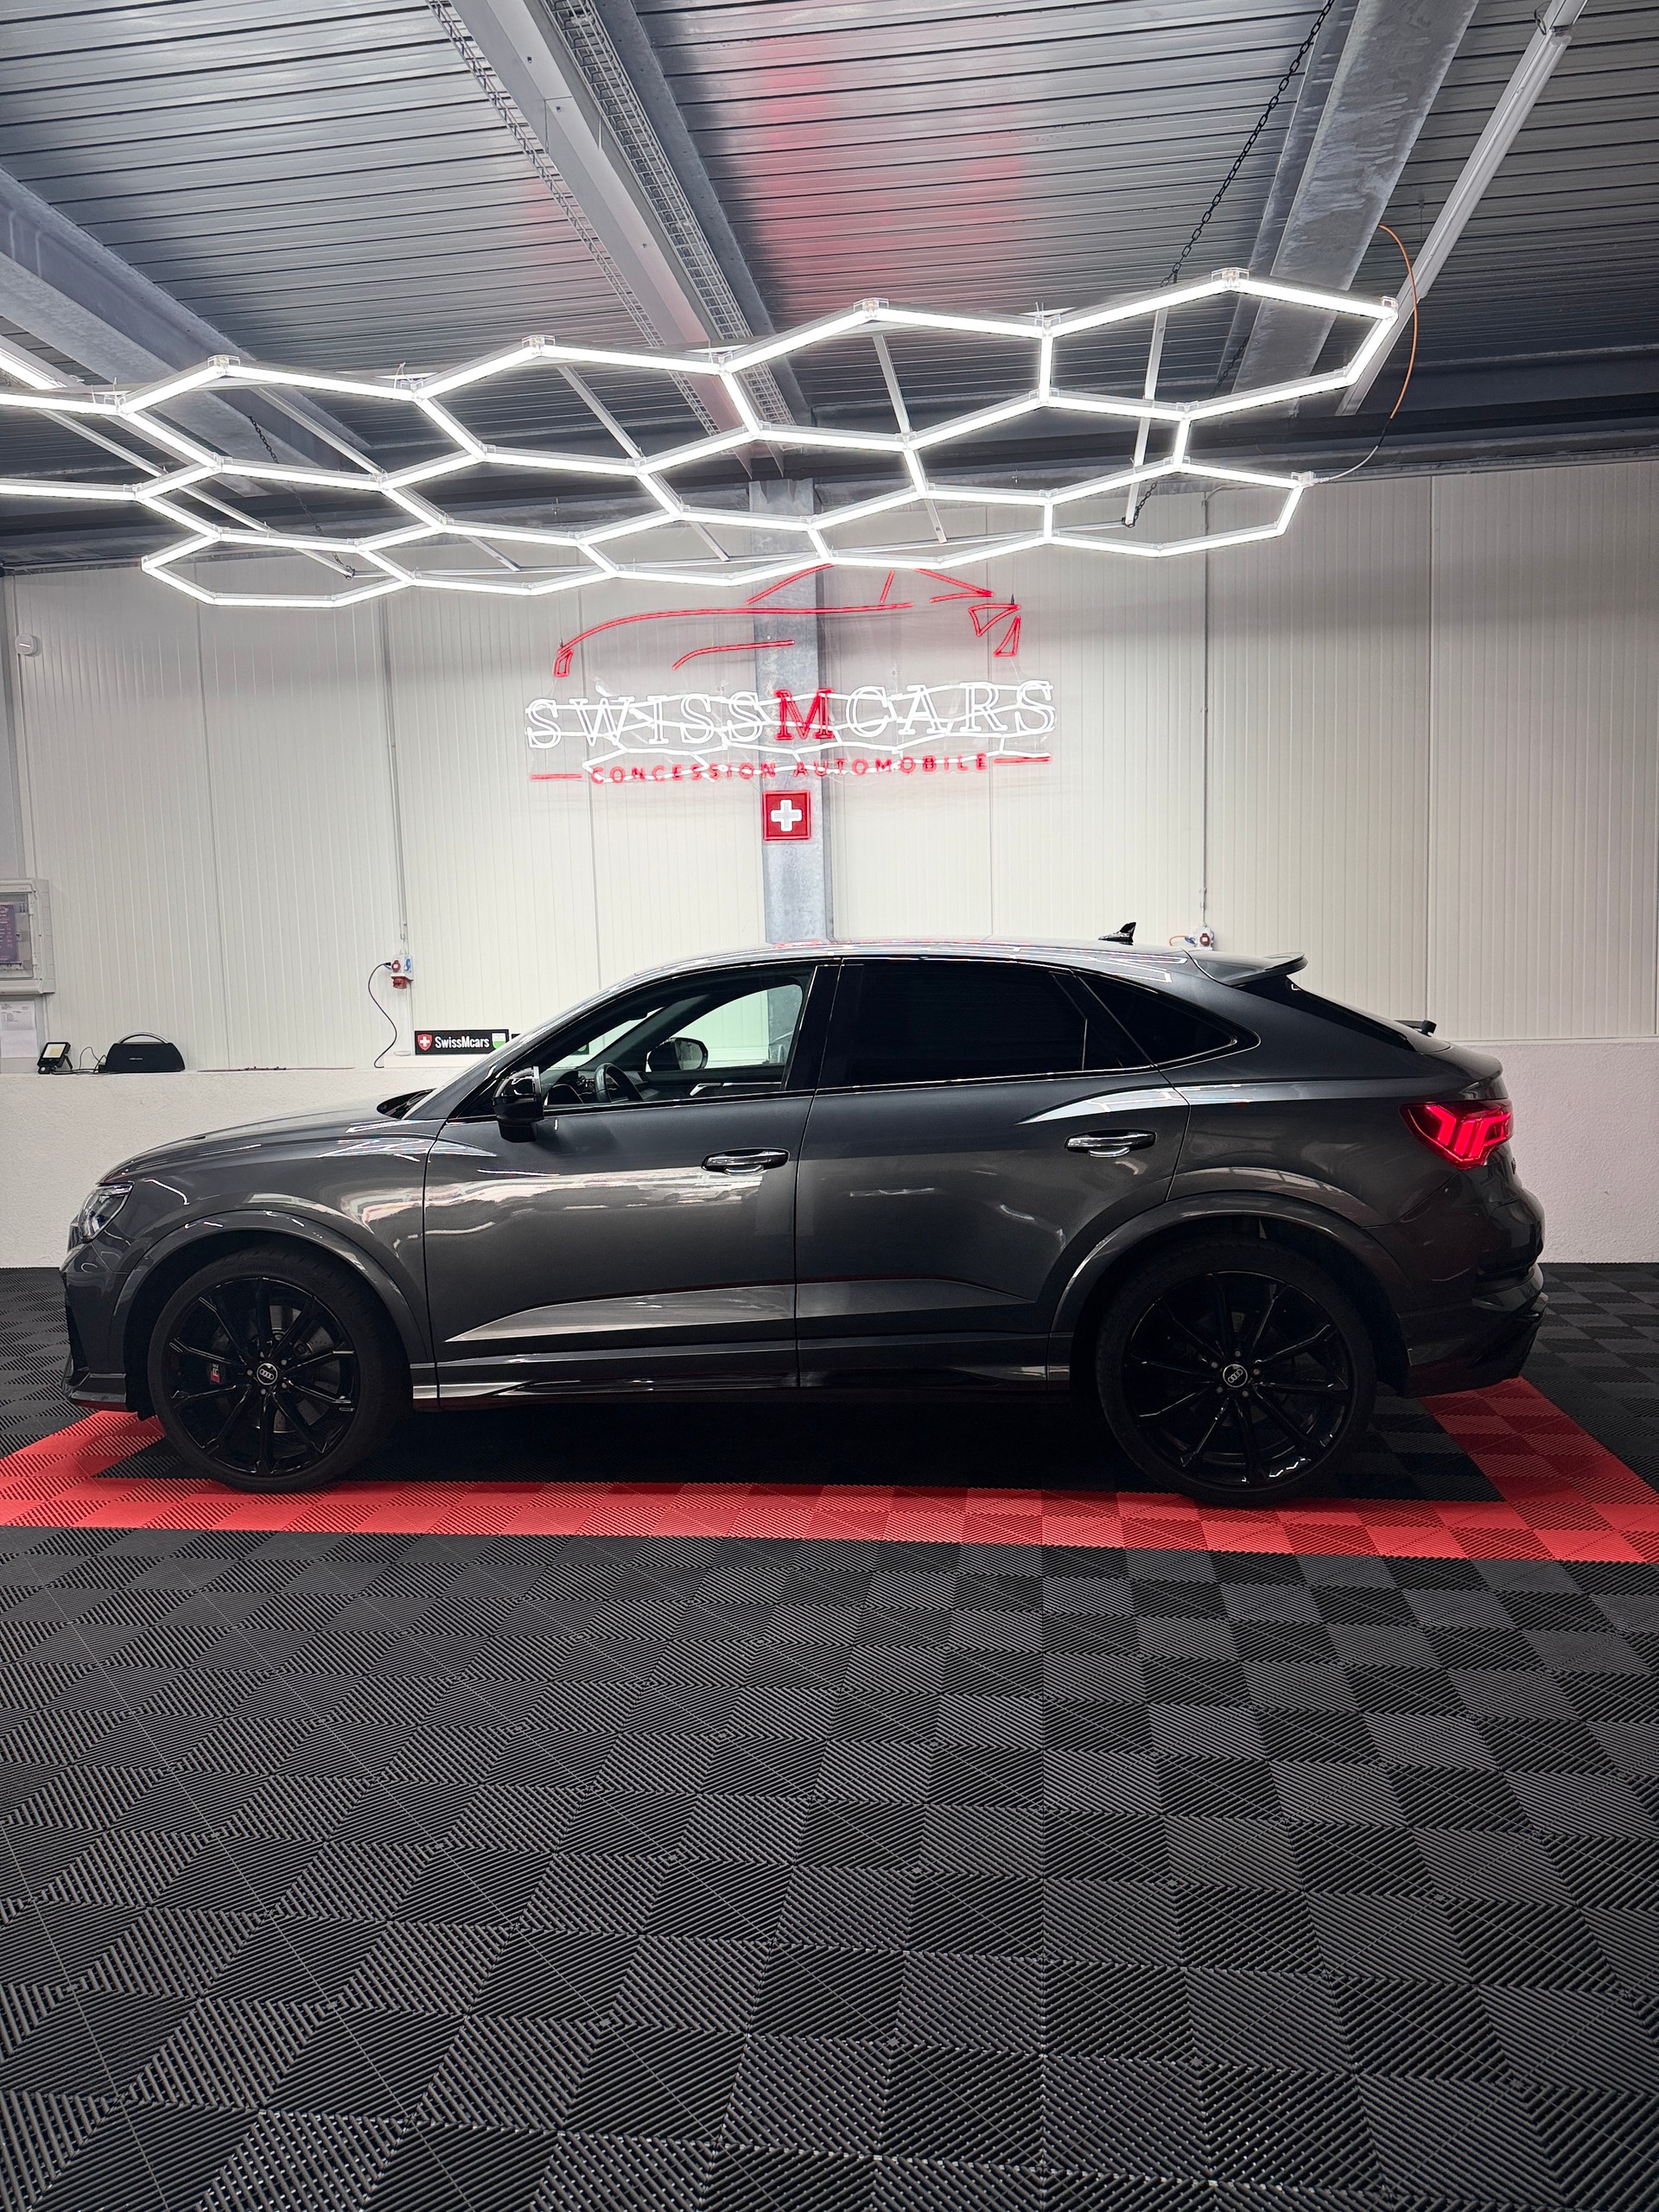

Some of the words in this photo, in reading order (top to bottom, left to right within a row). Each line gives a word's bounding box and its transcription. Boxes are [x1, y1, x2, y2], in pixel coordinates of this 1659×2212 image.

[525, 680, 1056, 748] SWISSMCARS
[591, 761, 777, 785] CONCESSION
[794, 753, 988, 778] AUTOMOBILE
[435, 1036, 490, 1049] SwissMcars
